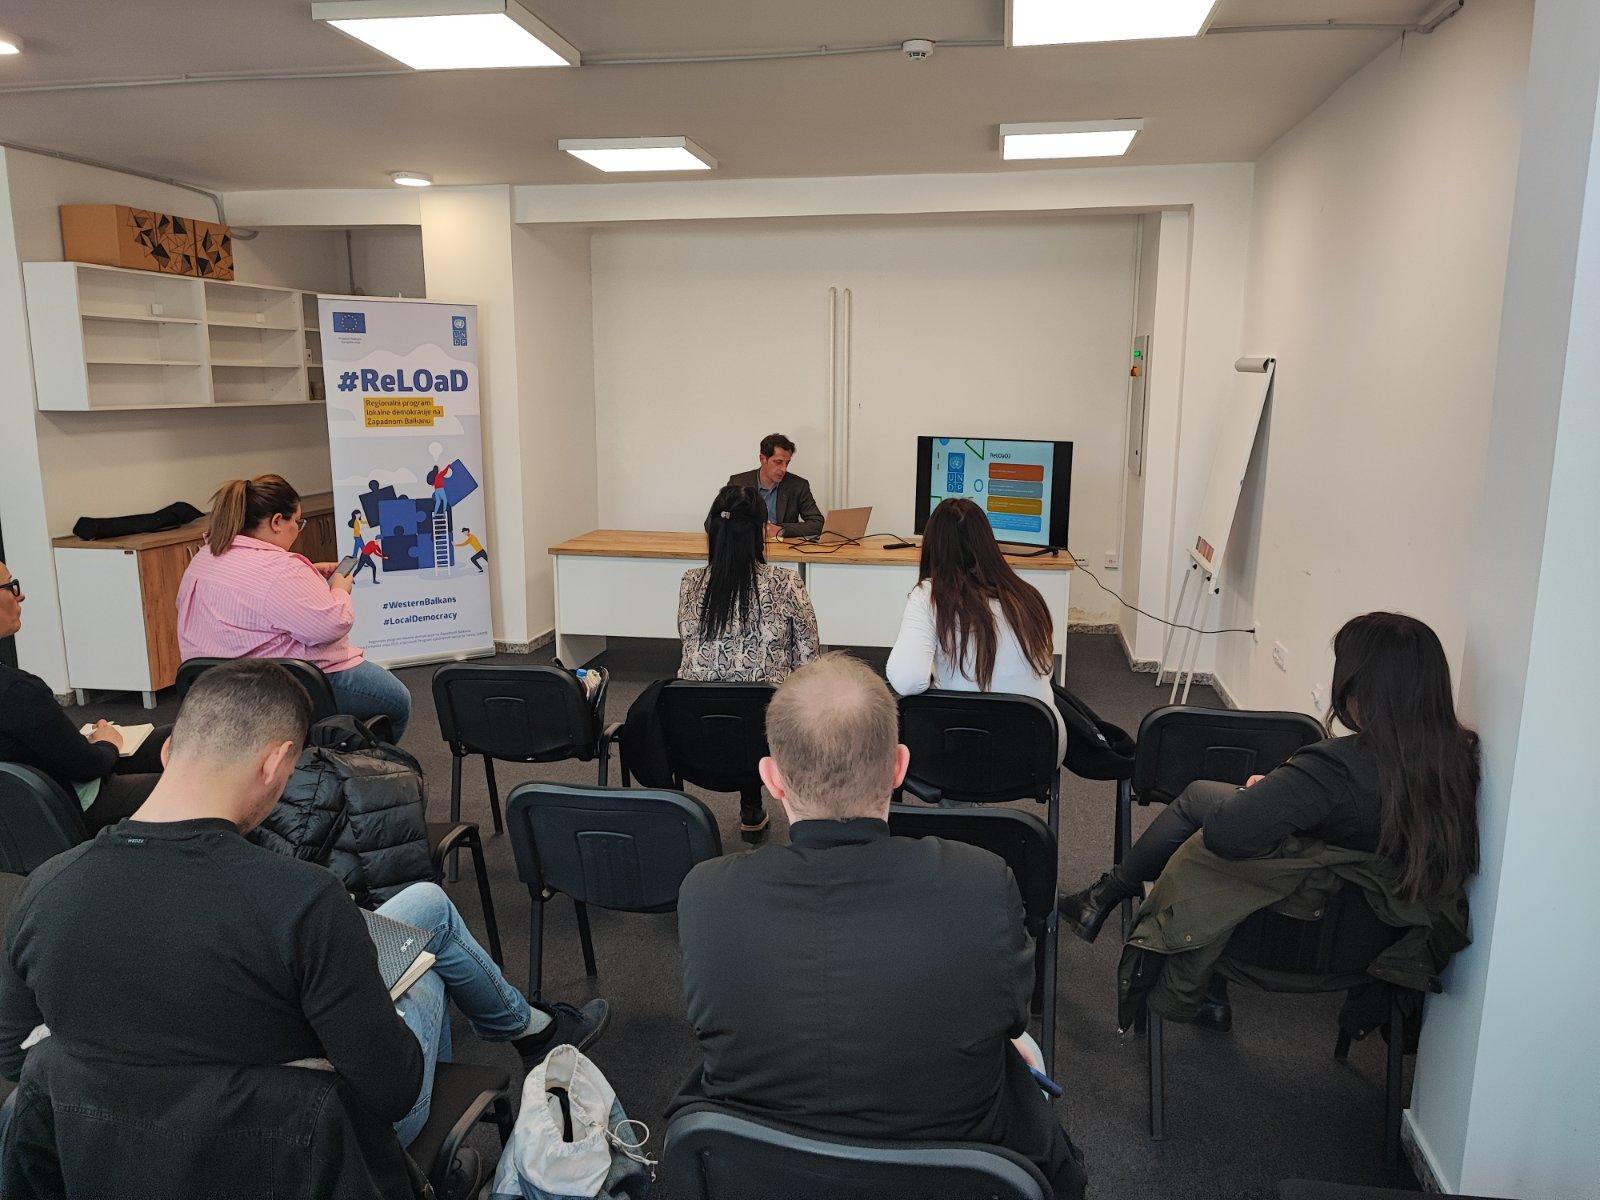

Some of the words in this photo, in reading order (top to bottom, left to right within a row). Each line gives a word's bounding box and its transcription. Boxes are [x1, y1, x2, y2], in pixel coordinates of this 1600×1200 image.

[338, 368, 469, 393] #ReLOaD
[366, 399, 402, 408] Regionalni
[402, 400, 431, 408] program
[367, 418, 403, 426] Zapadnom
[382, 596, 457, 610] #WesternBalkans
[383, 612, 458, 626] #LocalDemocracy
